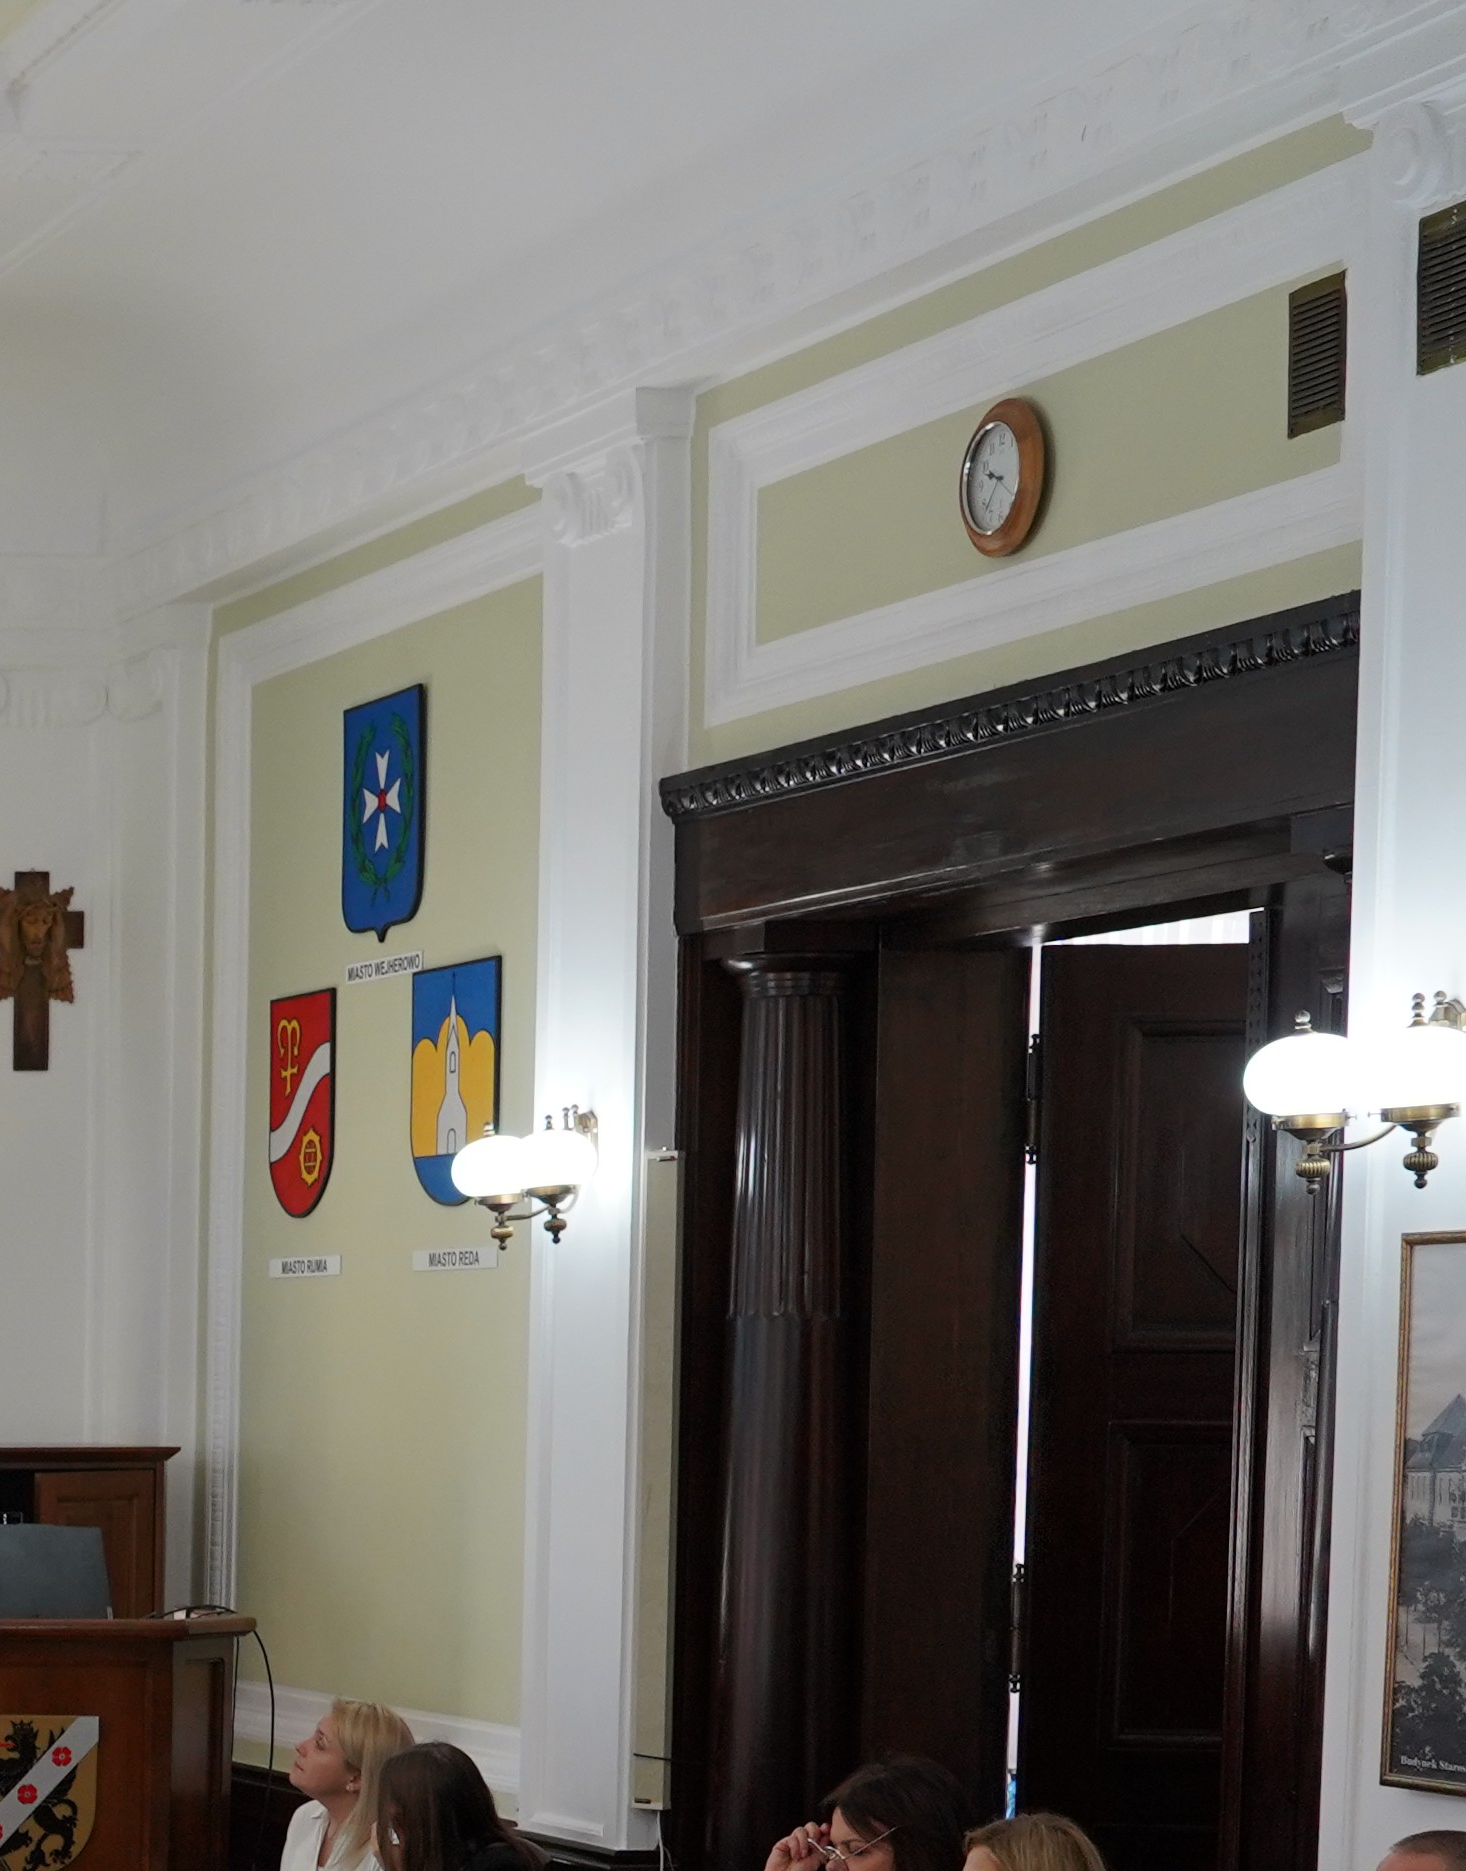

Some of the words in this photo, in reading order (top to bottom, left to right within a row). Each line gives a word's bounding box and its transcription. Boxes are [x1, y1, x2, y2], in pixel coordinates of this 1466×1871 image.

[347, 963, 373, 981] MIASTO
[374, 954, 420, 977] WEJHEROWO
[281, 1259, 305, 1275] MIASTO
[306, 1258, 328, 1274] RUMIA
[428, 1251, 457, 1267] MIASTO
[458, 1250, 480, 1266] REDA
